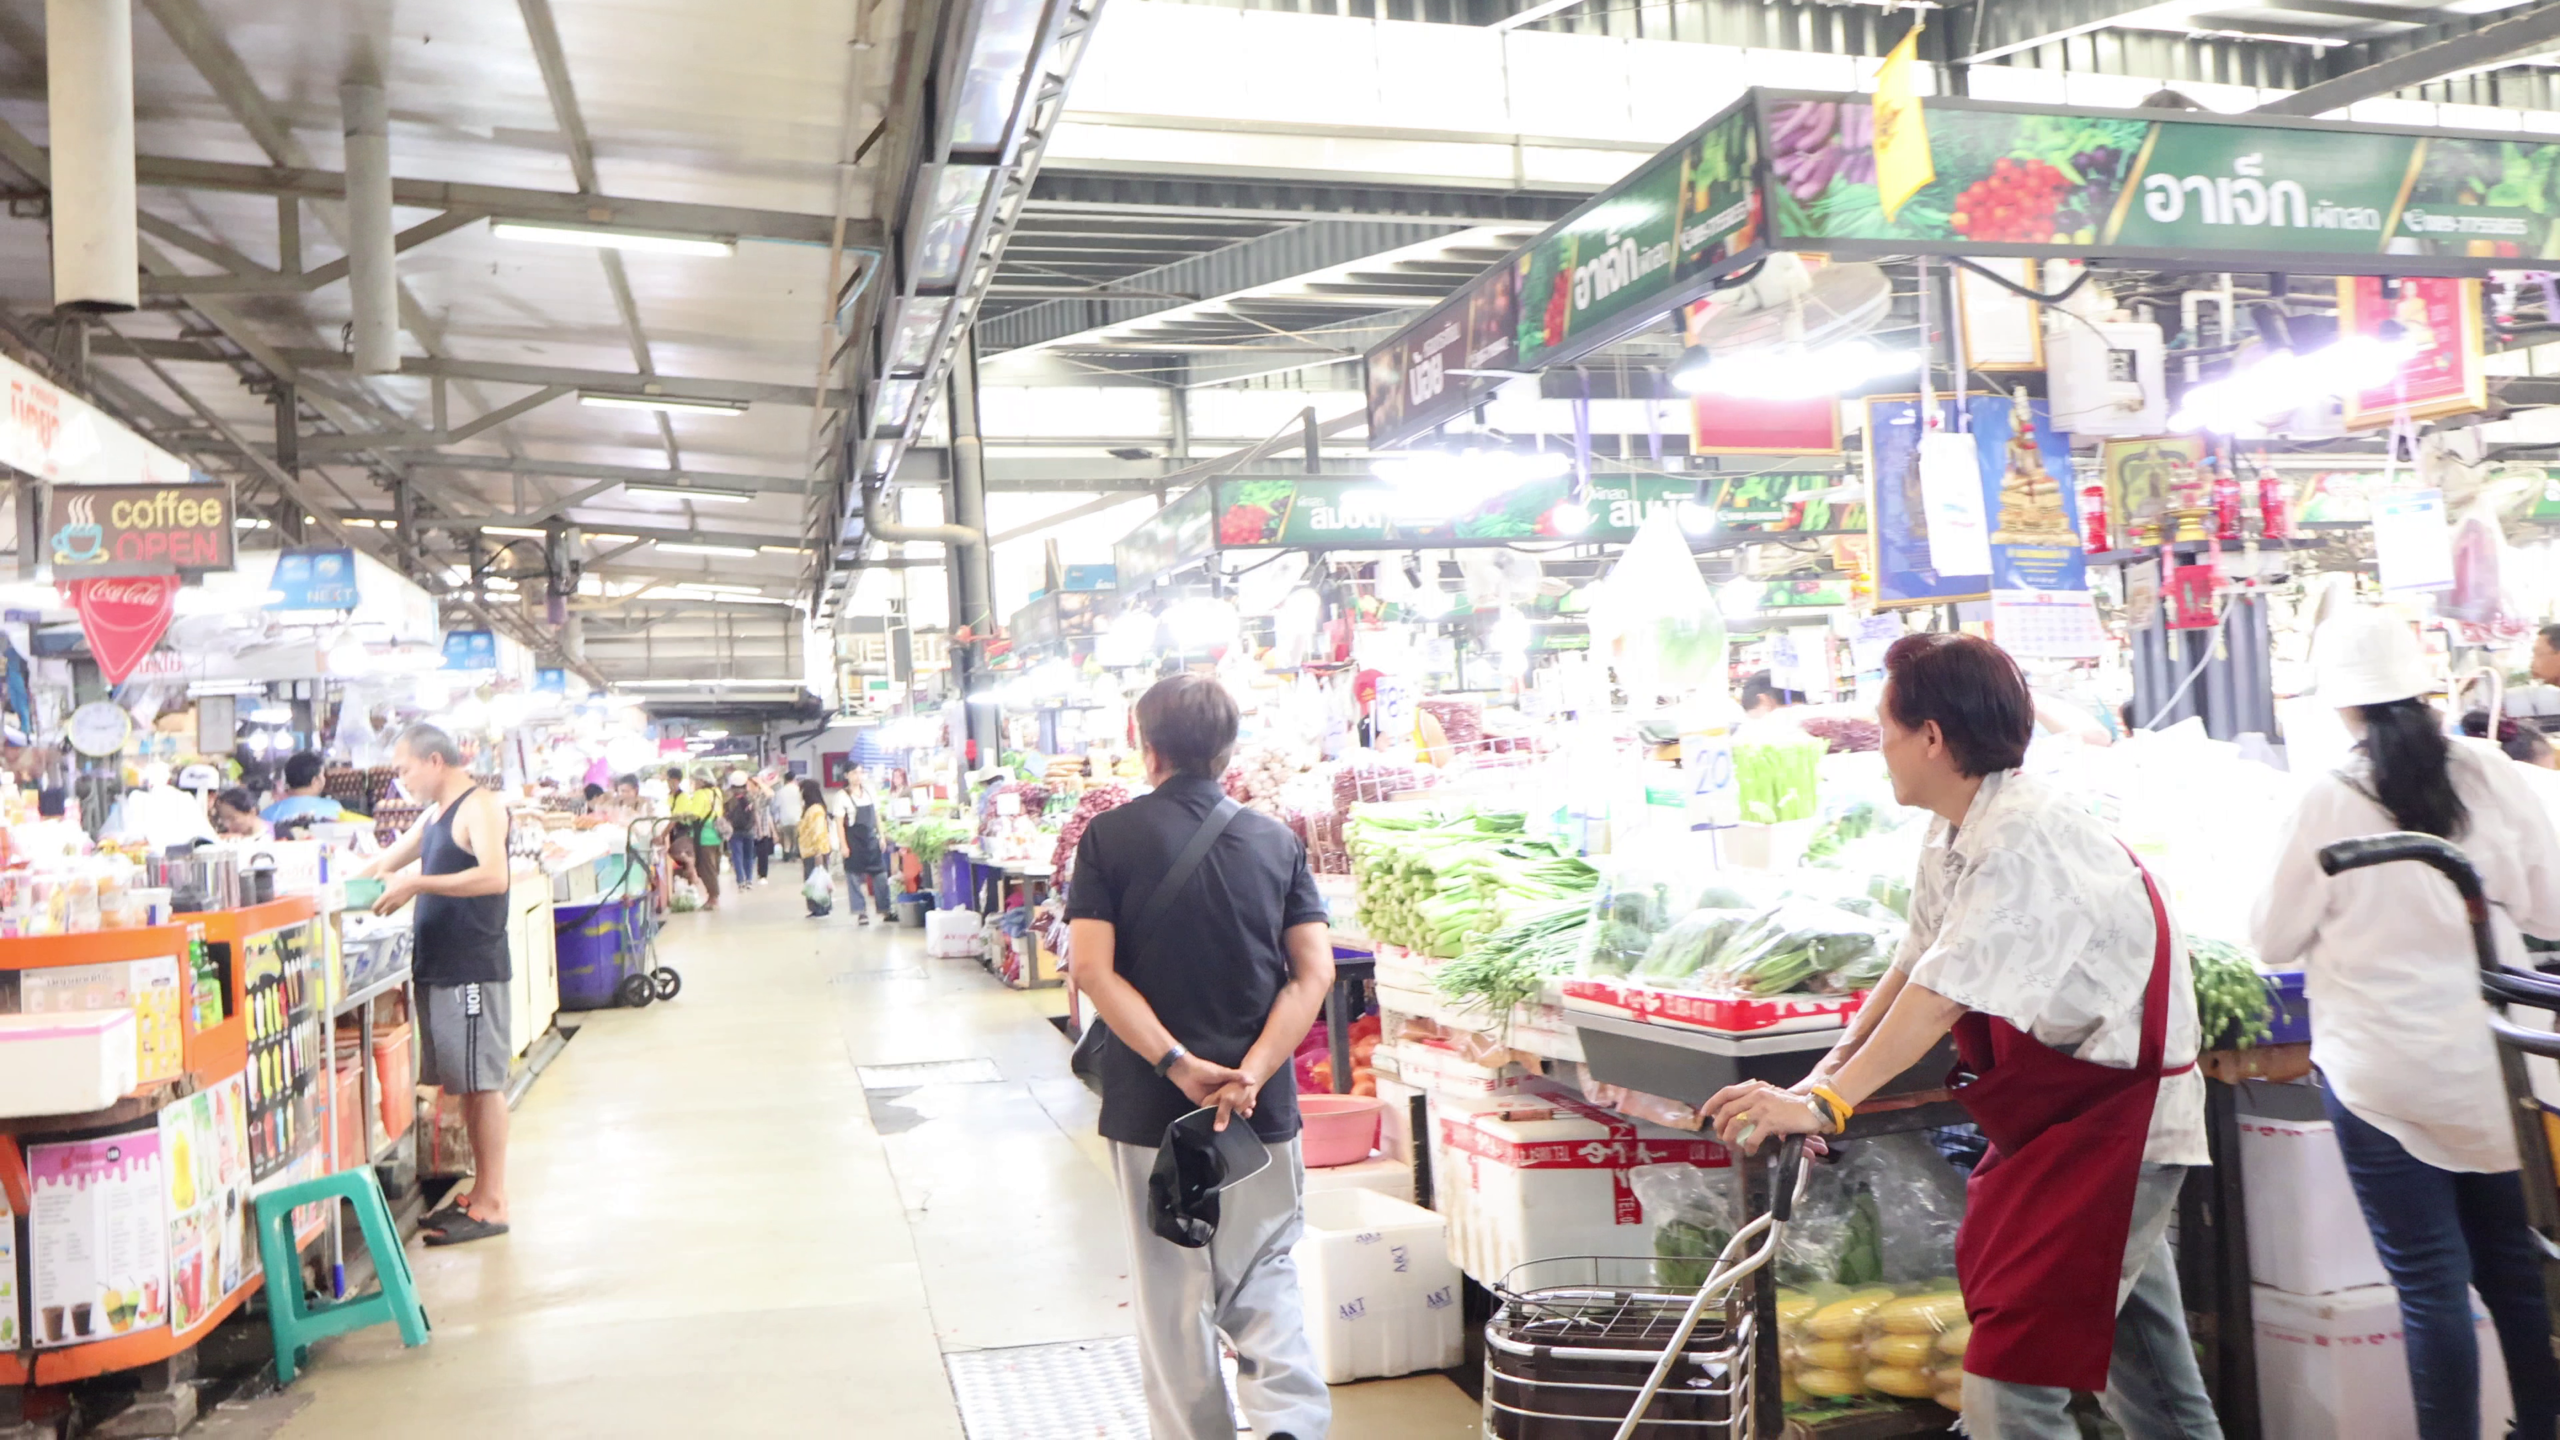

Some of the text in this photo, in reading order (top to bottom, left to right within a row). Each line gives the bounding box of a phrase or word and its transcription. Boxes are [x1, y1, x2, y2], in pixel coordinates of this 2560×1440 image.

[2143, 152, 2381, 230] อาเจ็ก ผักสด
[1574, 230, 1639, 310] อาเจ็ก
[112, 491, 222, 528] coffee
[116, 532, 218, 564] OPEN
[307, 589, 353, 604] NEXT
[1695, 750, 1731, 795] 20
[1390, 1245, 1407, 1273] A&T
[1339, 1297, 1365, 1319] A&T
[1426, 1285, 1451, 1308] A&T
